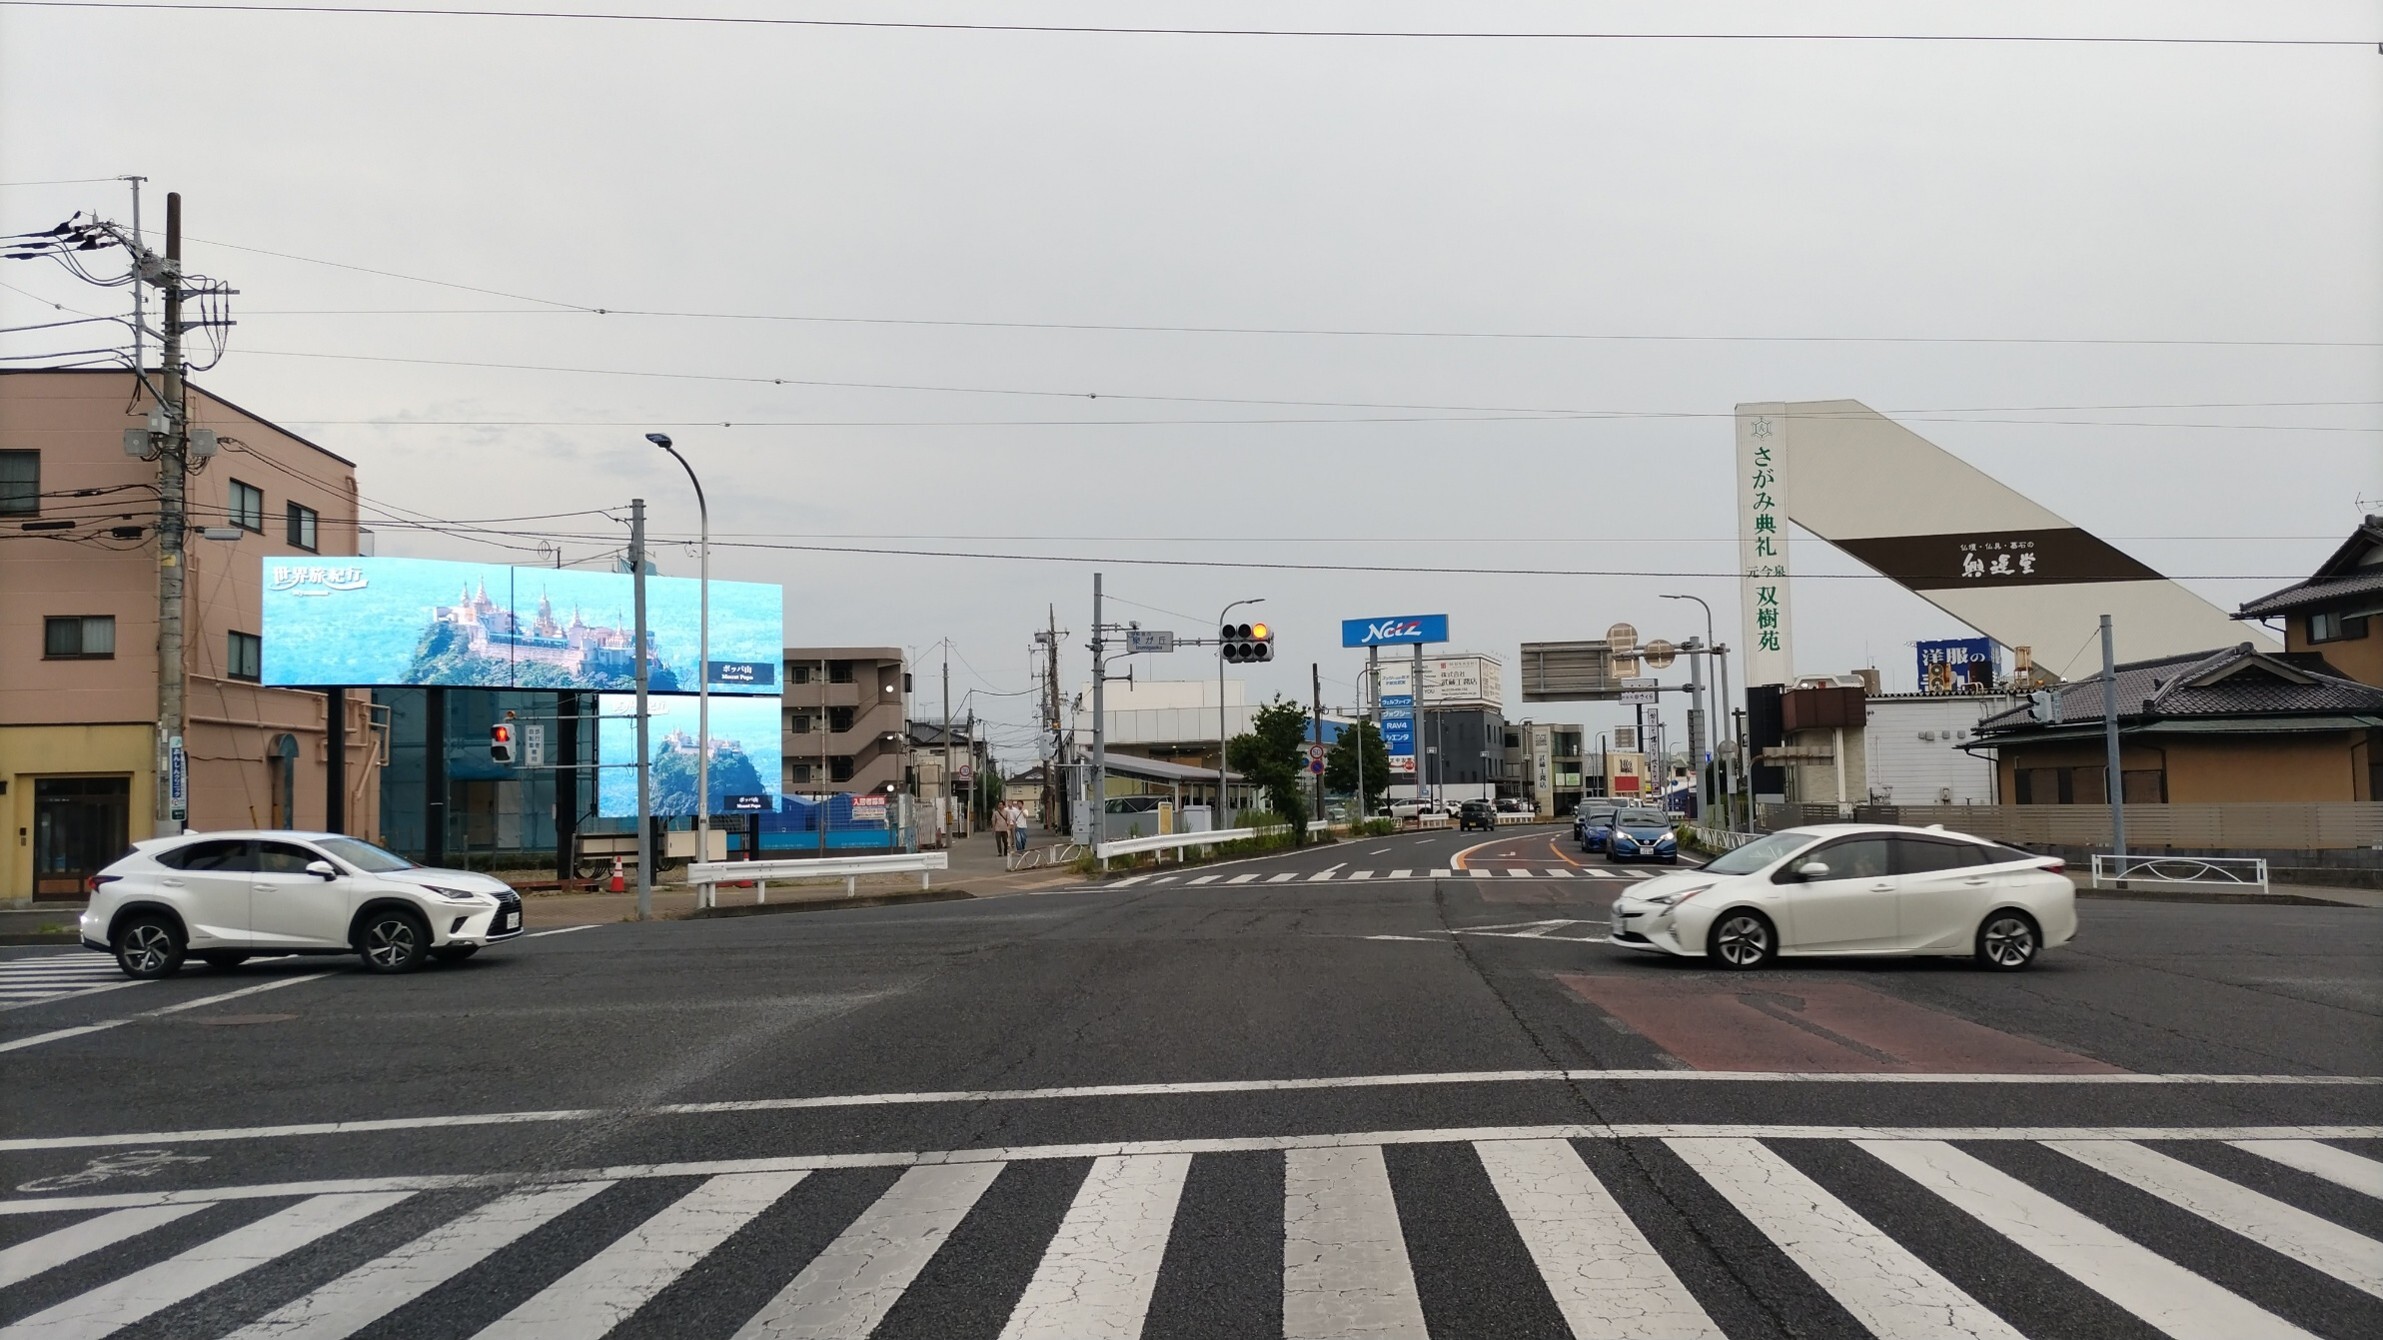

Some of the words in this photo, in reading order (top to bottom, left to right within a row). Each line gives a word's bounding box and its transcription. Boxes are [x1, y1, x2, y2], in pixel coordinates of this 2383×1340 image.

[1752, 446, 1777, 557] さがみ典礼
[1960, 541, 2035, 551] 仏壇・仏具・墓石の
[272, 565, 364, 585] 世界旅紀行
[1746, 565, 1786, 578] 元今泉
[1756, 586, 1780, 652] 双樹苑
[1361, 620, 1422, 643] Netz
[1922, 647, 1986, 666] 洋服の
[1386, 733, 1409, 741] シエンタ
